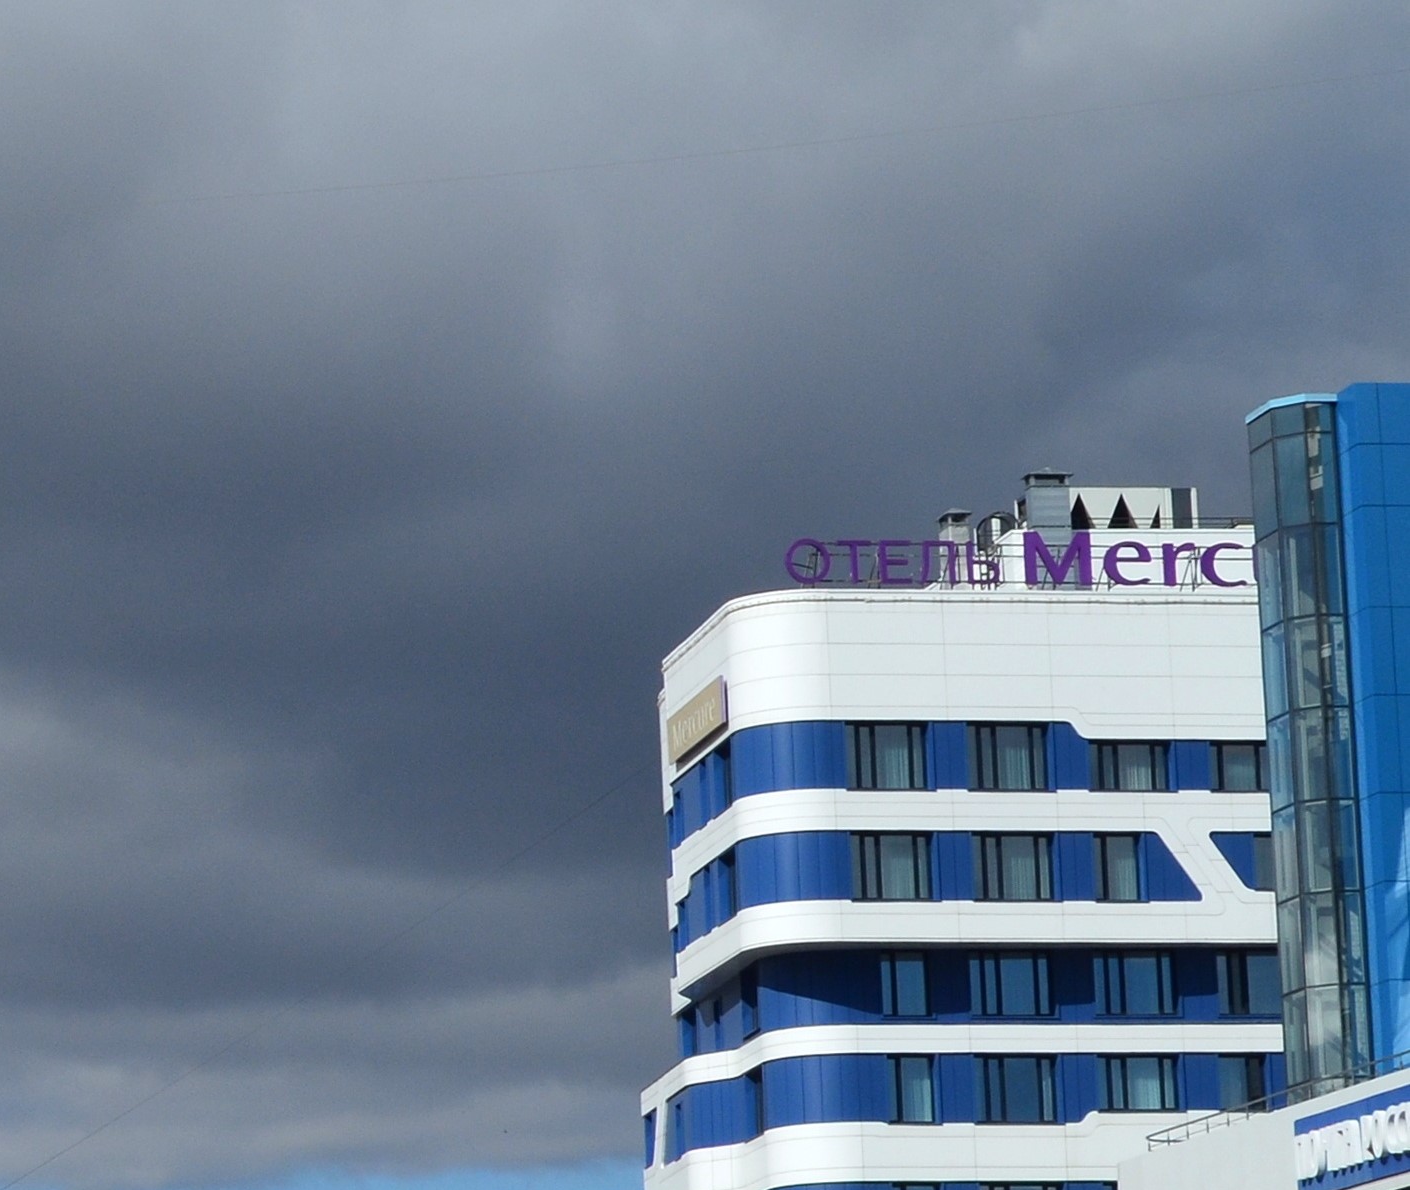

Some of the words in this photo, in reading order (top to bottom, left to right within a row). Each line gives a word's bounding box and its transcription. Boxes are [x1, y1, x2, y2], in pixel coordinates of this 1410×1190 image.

[785, 537, 1000, 586] ОТЕЛЬ
[1022, 530, 1258, 587] Merc
[672, 696, 716, 752] Mercure
